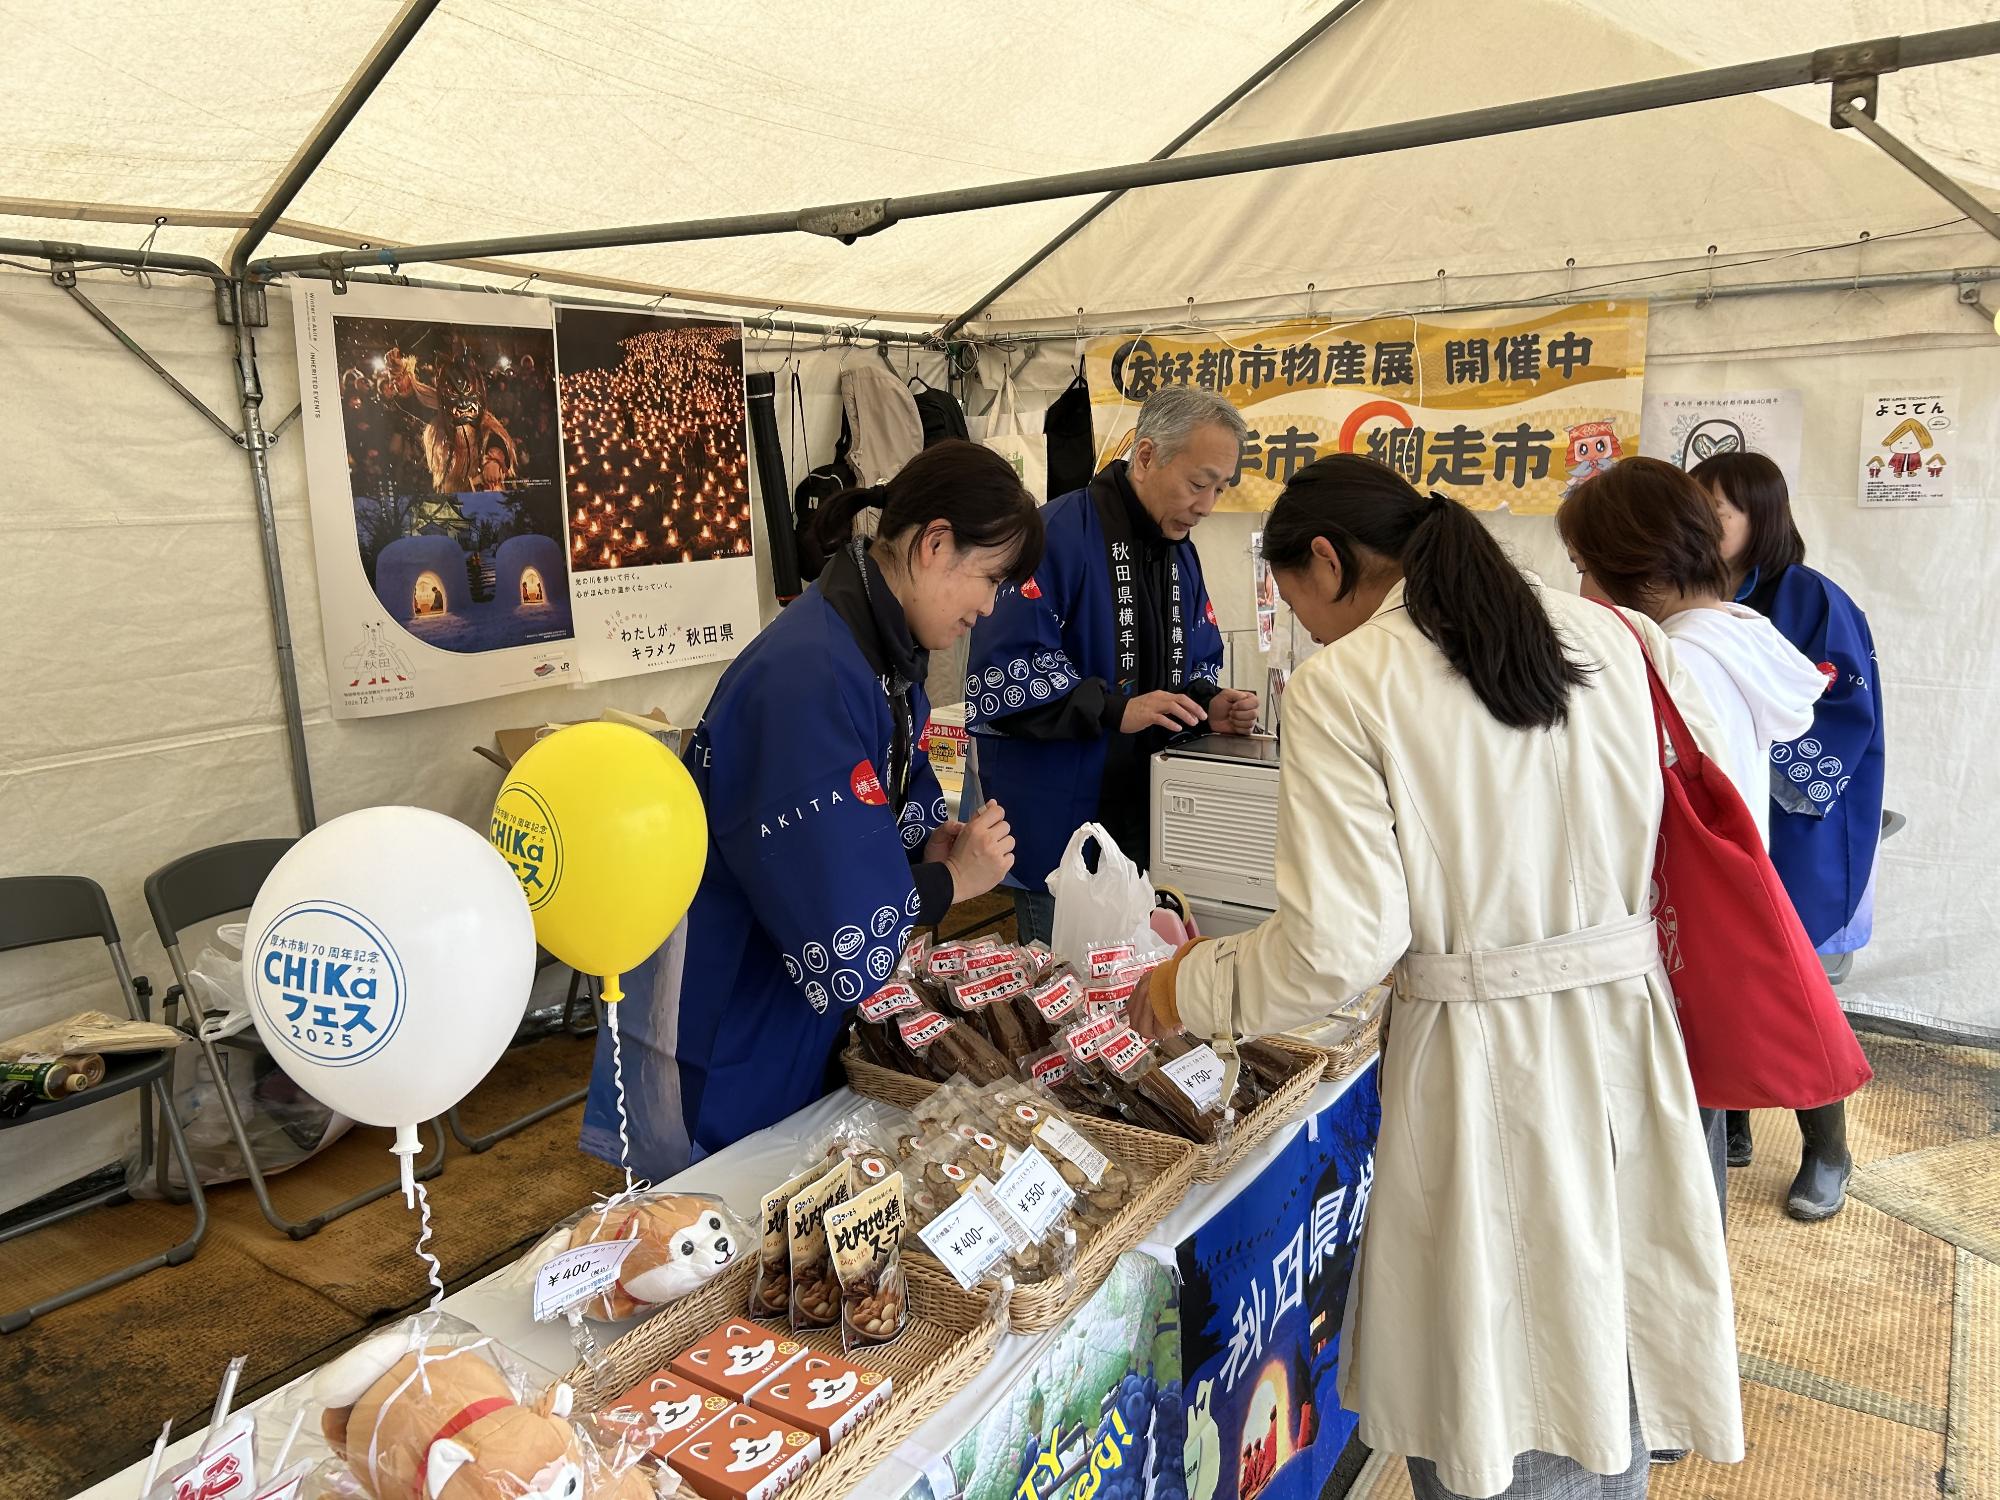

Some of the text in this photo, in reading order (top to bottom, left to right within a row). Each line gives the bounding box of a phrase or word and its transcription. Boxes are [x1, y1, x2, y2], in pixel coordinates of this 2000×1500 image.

[1128, 331, 1594, 397] 友好都市物産展 開催中
[310, 352, 321, 419] INHERITED EVENTS
[1876, 402, 1944, 416] よこてん
[1366, 422, 1555, 489] 網走市
[1111, 541, 1136, 671] 秋田県横手市
[620, 623, 735, 647] わたしが 秋田県
[1171, 562, 1184, 687] 秋田県横手市
[631, 642, 676, 660] キラメク
[561, 662, 570, 670] JR
[855, 777, 880, 795] 横手
[517, 817, 548, 834] 周年記念
[761, 790, 844, 838] AKITA
[270, 934, 380, 963] 厚木市制 70 周年記念
[264, 951, 377, 1000] CHiKa
[357, 966, 376, 974] チカ
[970, 981, 1022, 1003] いぶりがっこ
[282, 992, 378, 1034] フェス
[291, 1025, 353, 1047] 2025
[834, 1194, 902, 1253] 比内地鶏
[868, 1220, 905, 1261] スープ
[761, 1360, 781, 1375] AKITA
[845, 1391, 864, 1406] AKITA
[685, 1416, 706, 1432] AKITA
[767, 1453, 788, 1469] AKITA
